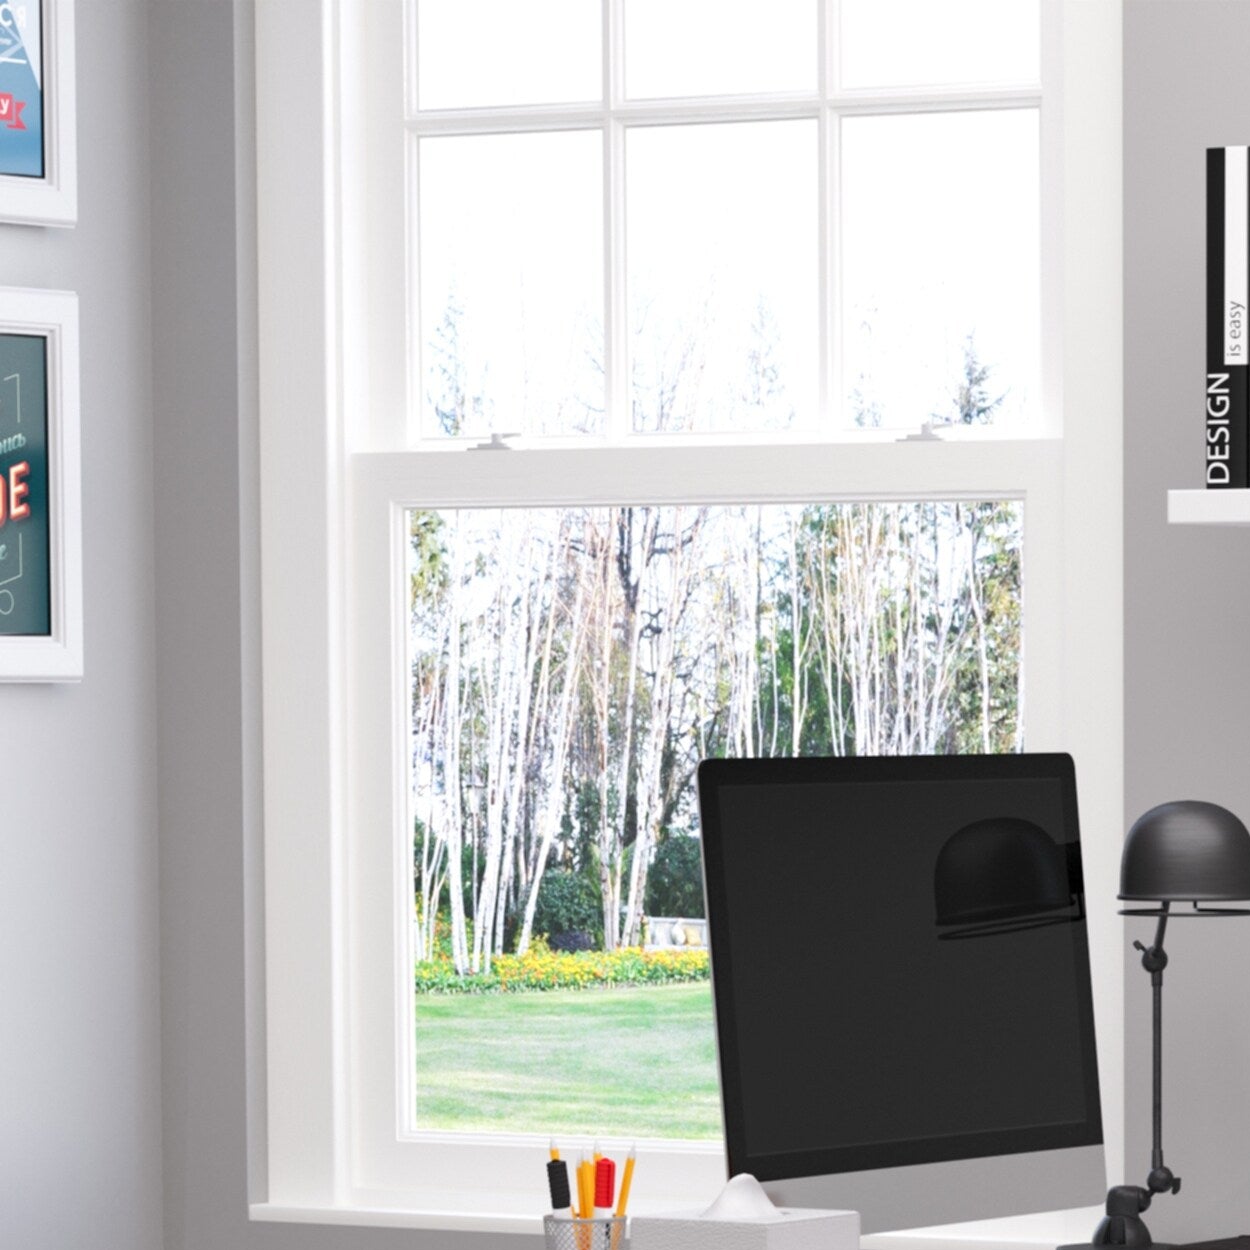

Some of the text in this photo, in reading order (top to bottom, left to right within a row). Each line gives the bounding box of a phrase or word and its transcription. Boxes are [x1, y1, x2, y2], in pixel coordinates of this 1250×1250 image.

[1227, 300, 1246, 357] is easy
[1207, 373, 1230, 484] DESIGN
